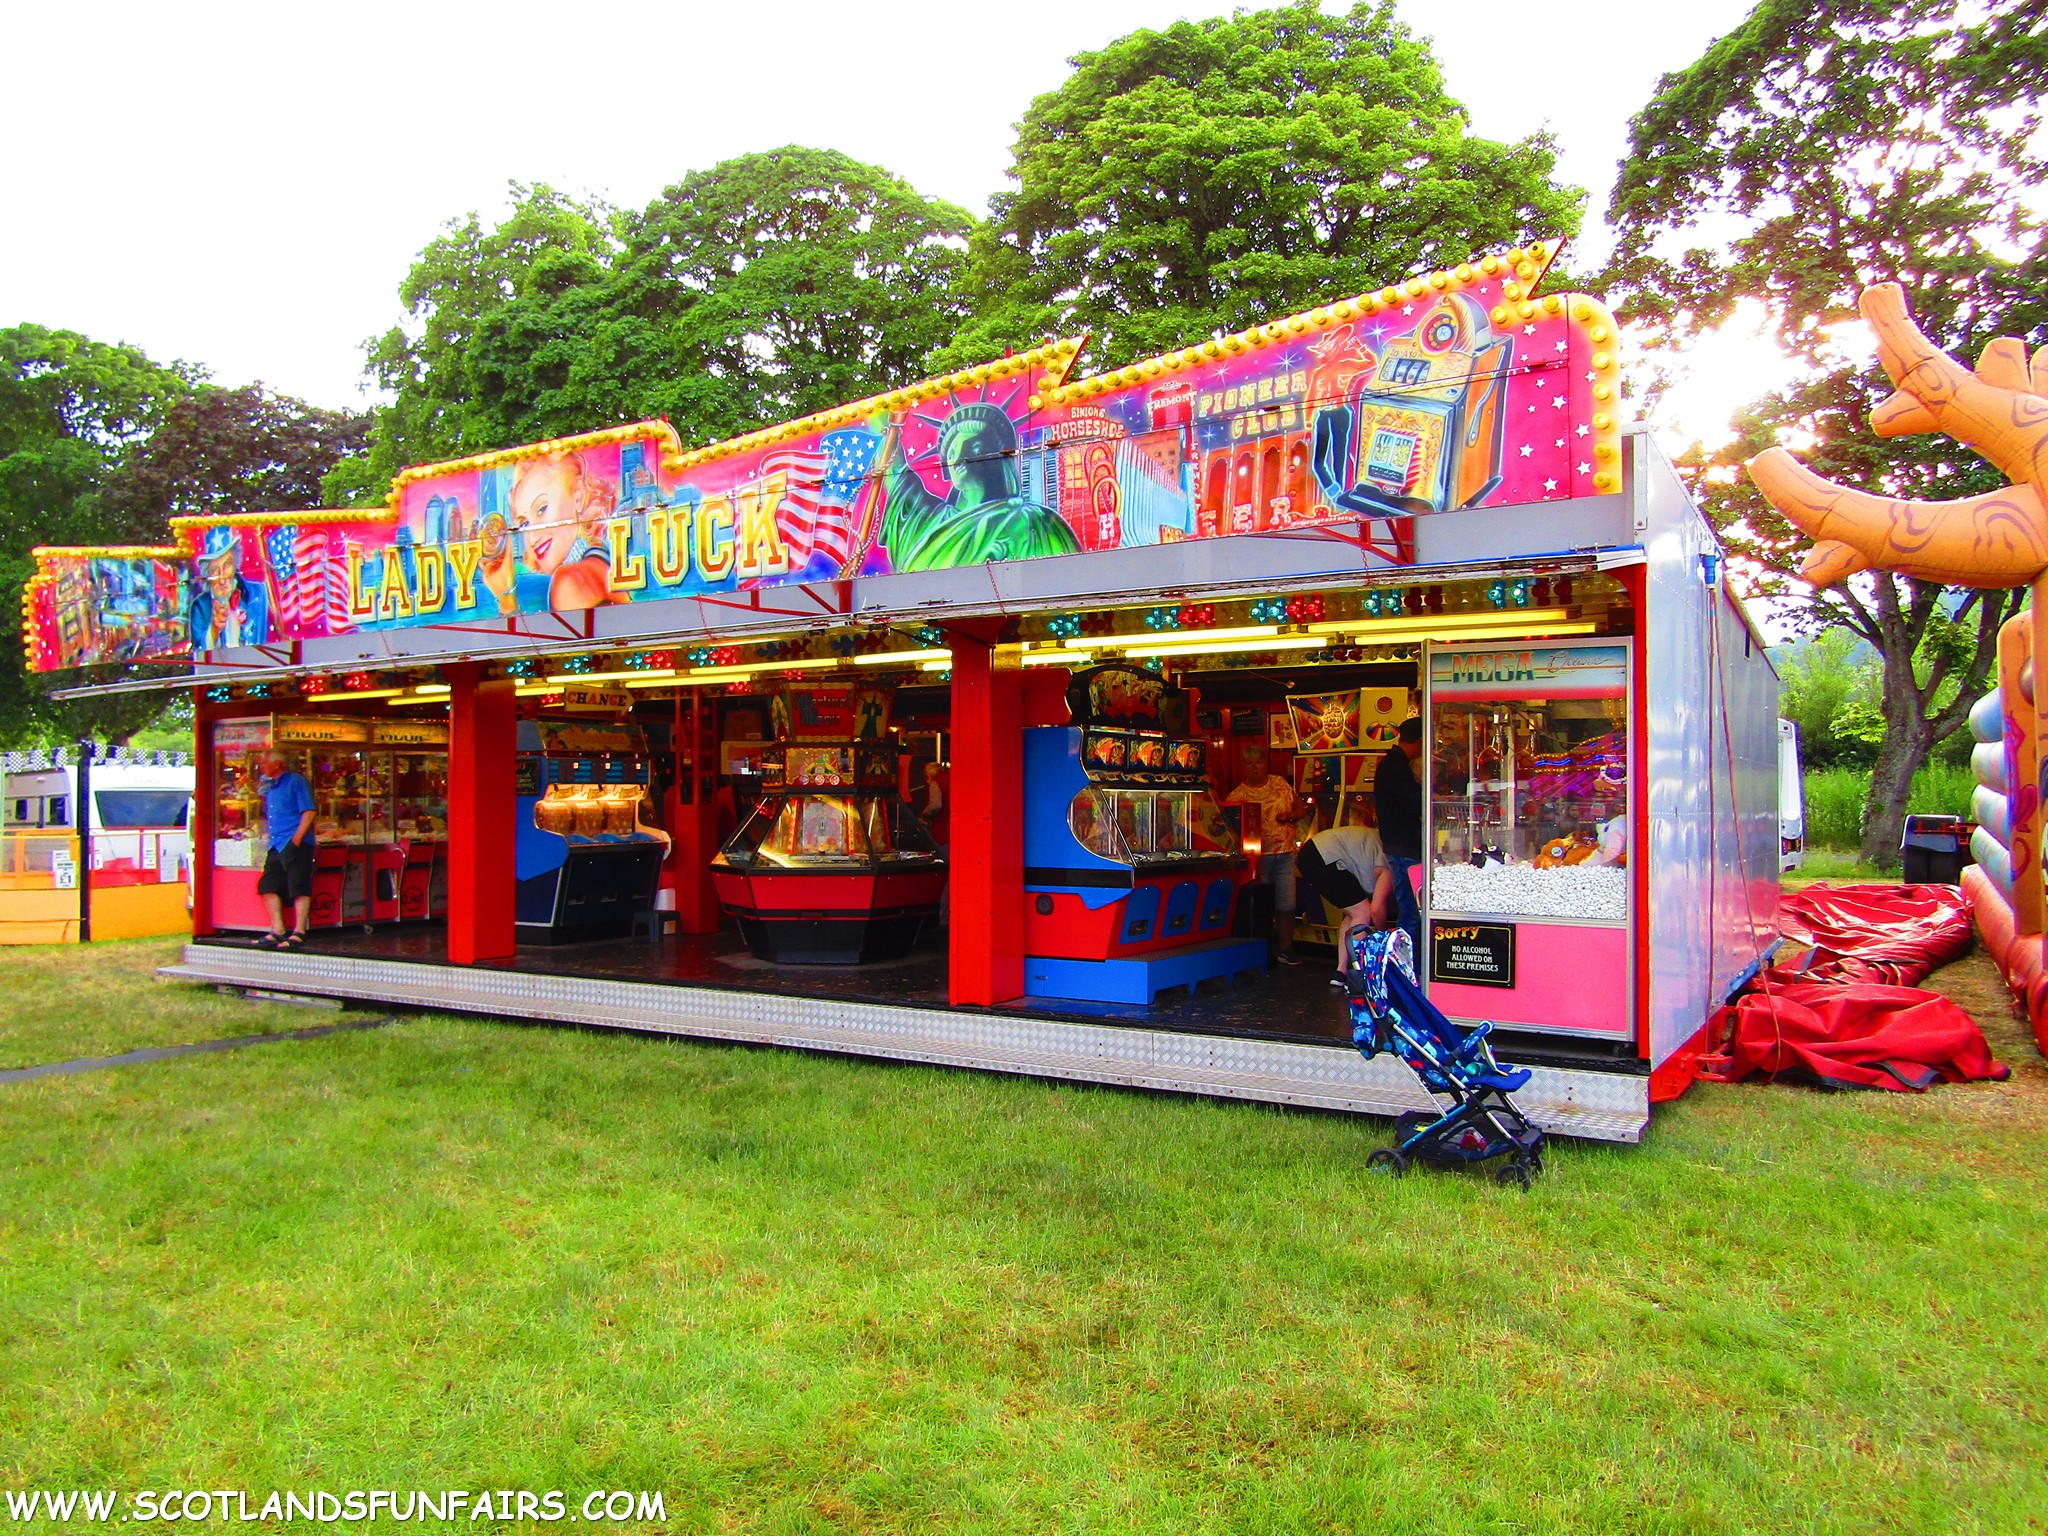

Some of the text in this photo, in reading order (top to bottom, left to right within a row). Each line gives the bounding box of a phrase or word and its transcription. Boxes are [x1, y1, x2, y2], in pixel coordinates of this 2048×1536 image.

[1146, 390, 1198, 416] FREMONT
[1199, 372, 1308, 418] PIONEER
[1050, 418, 1125, 442] HORSESHOE
[1231, 401, 1297, 440] CLUB
[607, 468, 789, 594] LUCK
[346, 539, 483, 625] LADY
[1452, 651, 1535, 683] MEGA
[566, 691, 628, 707] CHANGE
[59, 874, 72, 884] £1
[1434, 925, 1480, 941] Sorry
[1451, 945, 1492, 955] NO ALCOHOL
[1451, 954, 1483, 963] ALLOWED
[1446, 961, 1499, 972] THESE PREMISES
